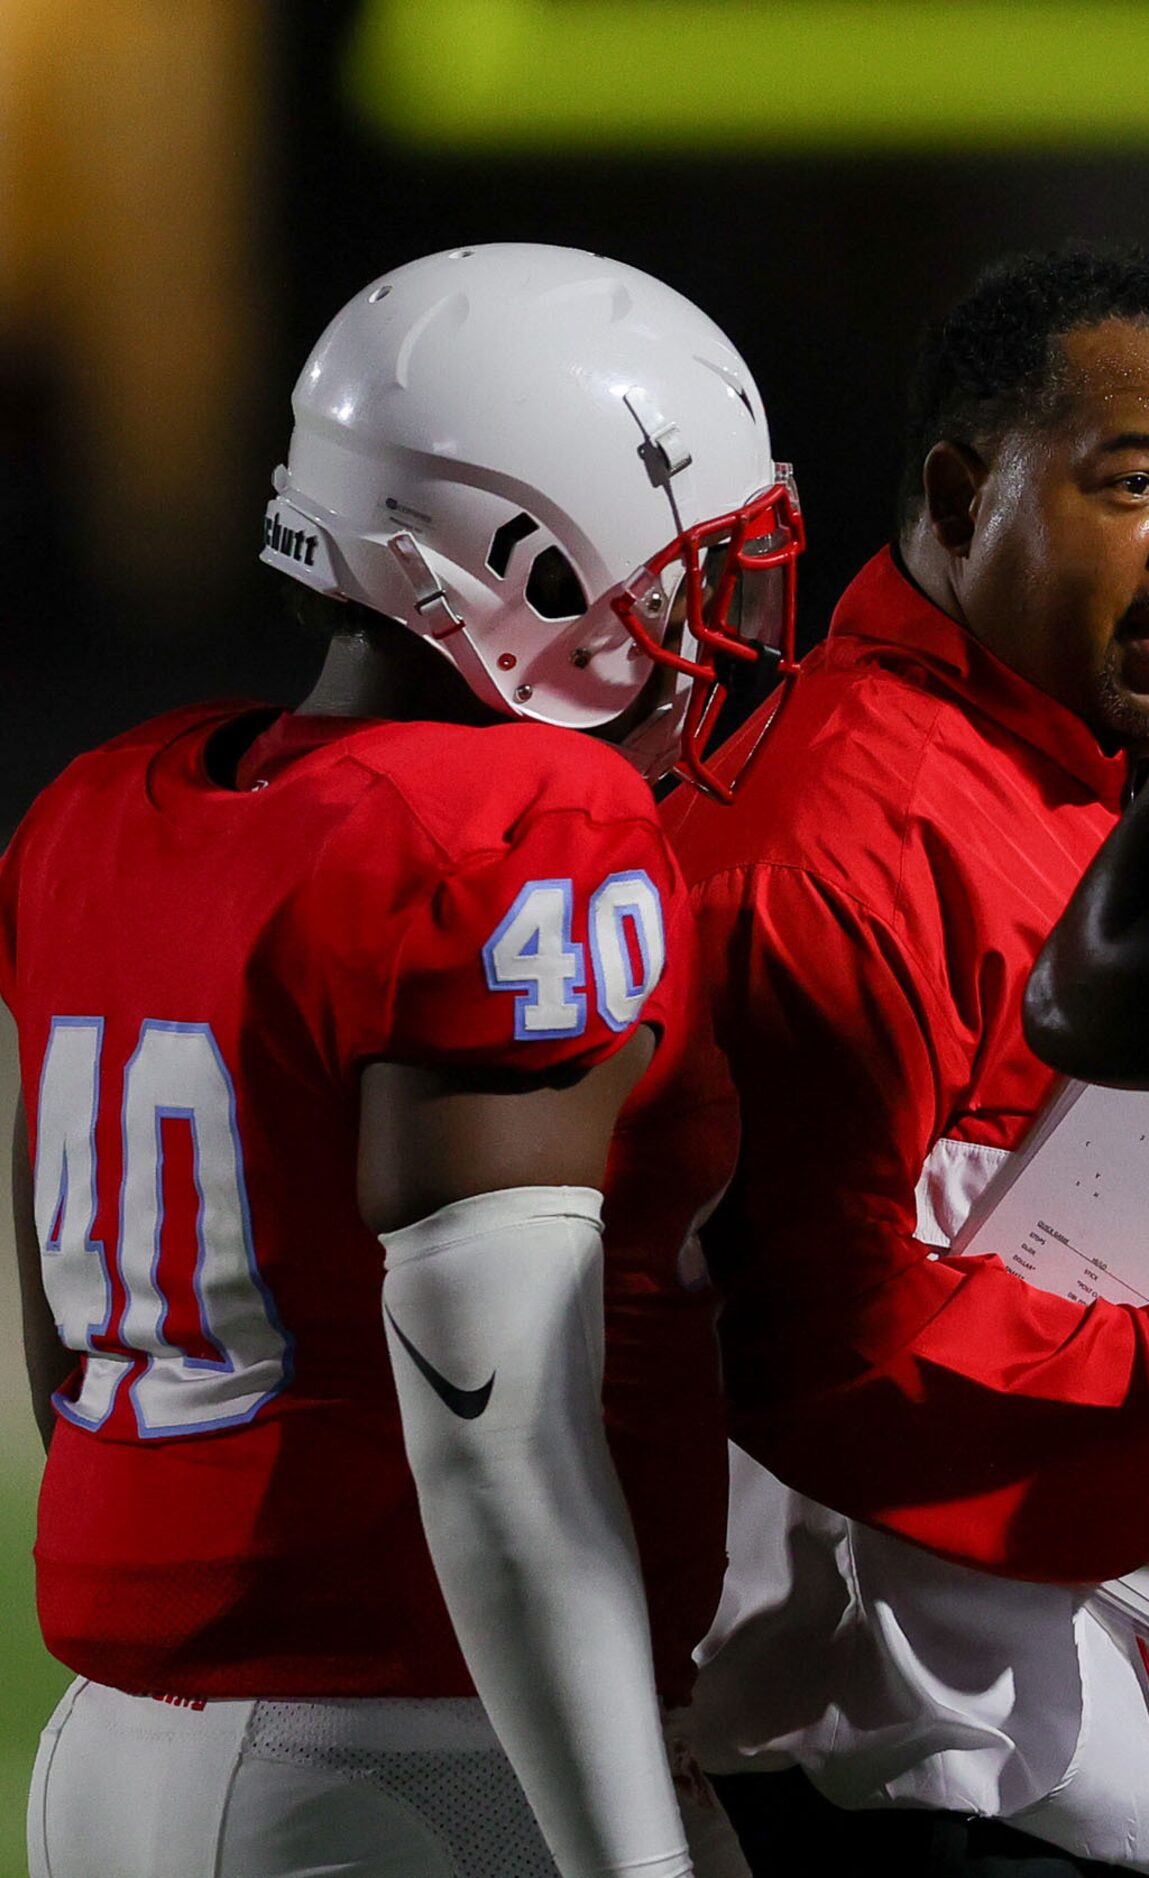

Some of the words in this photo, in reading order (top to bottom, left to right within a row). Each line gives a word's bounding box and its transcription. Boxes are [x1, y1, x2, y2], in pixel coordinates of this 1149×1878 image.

[264, 513, 319, 567] chutt
[481, 869, 666, 1041] 40
[34, 1015, 296, 1440] 40
